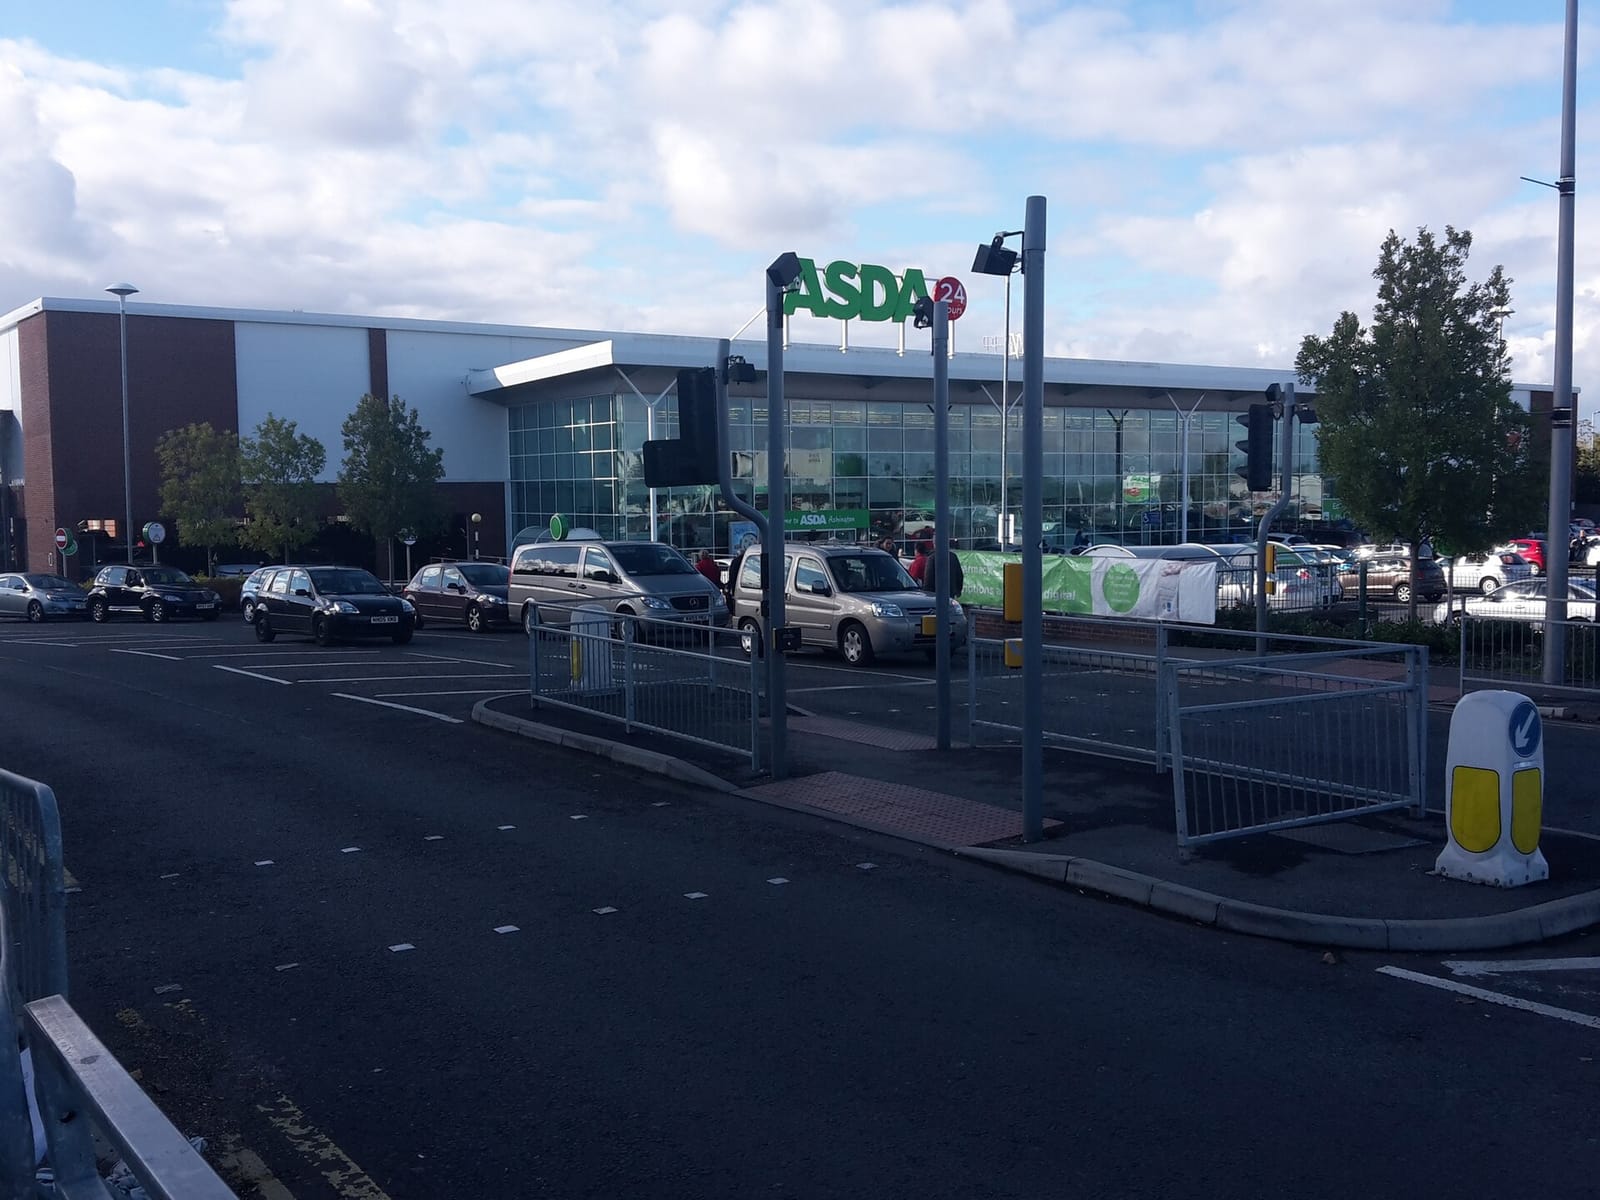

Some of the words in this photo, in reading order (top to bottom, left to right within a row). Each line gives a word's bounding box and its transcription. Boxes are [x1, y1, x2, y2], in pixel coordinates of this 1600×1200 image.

[783, 257, 929, 323] ASDA
[941, 282, 965, 304] 24
[947, 305, 963, 315] ours
[800, 514, 827, 526] ASDA
